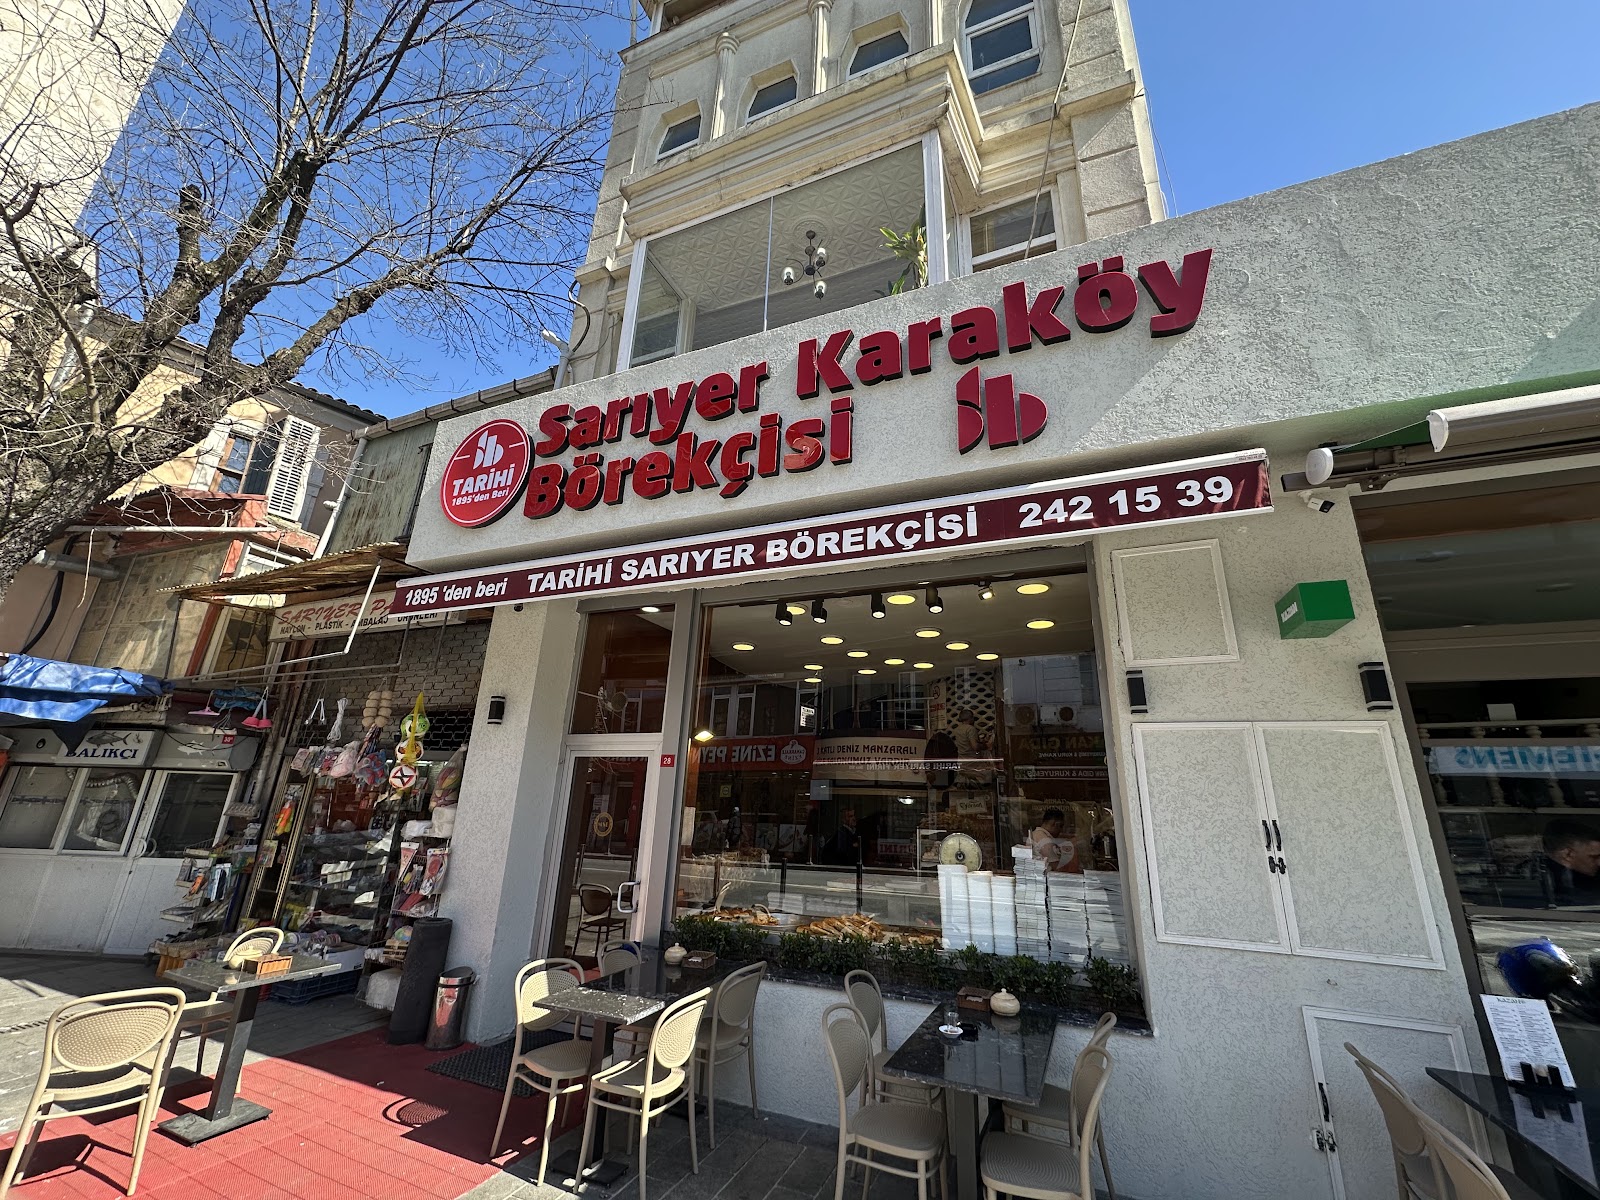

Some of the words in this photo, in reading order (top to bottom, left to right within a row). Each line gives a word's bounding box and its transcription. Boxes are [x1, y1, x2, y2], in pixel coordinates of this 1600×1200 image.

[535, 361, 770, 458] Sarıyer
[797, 248, 1214, 399] Karaköy
[523, 396, 854, 519] Börekçisi
[452, 463, 515, 497] TARİHİ
[452, 493, 490, 507] 1895'den
[491, 487, 510, 499] Beri
[405, 585, 439, 606] 1895
[442, 584, 472, 601] 'den
[475, 579, 507, 598] beri
[527, 559, 613, 594] TARİHİ
[621, 543, 755, 582] SARIYER
[765, 505, 979, 563] BÖREKÇİSİ
[1019, 496, 1094, 529] 242
[1108, 486, 1162, 517] 15
[1176, 475, 1234, 507] 39
[278, 601, 363, 626] SARIYER
[280, 624, 306, 635] NAYLON
[314, 618, 344, 631] PLASTİK
[65, 748, 139, 759] BALIKÇI
[863, 743, 917, 756] MANZARALI
[663, 757, 672, 765] 28
